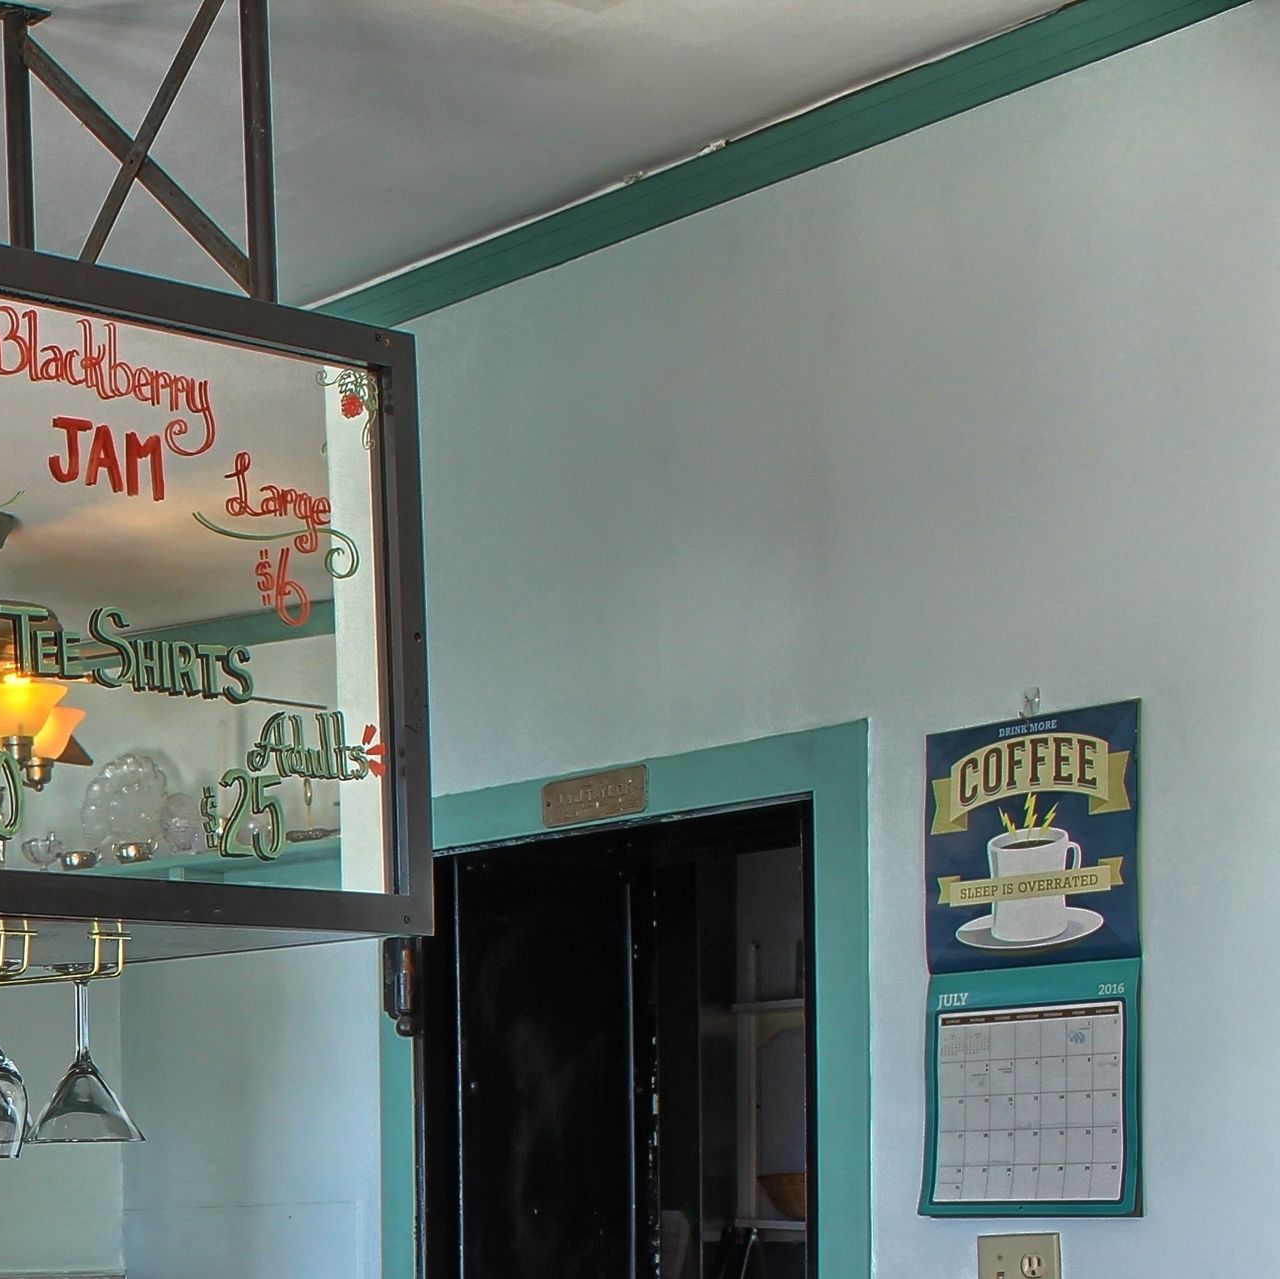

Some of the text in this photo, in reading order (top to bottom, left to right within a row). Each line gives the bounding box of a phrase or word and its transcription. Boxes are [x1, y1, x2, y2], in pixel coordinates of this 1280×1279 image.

[49, 416, 166, 502] JAM
[225, 451, 332, 554] Large
[255, 547, 311, 628] $6
[248, 710, 370, 782] Adults
[998, 719, 1058, 739] DRINK MORE
[959, 736, 1098, 807] COFFEE
[201, 767, 286, 860] $25
[960, 873, 1099, 900] SLEEP IS OVERRATED
[938, 982, 1125, 1010] JULY 2016
